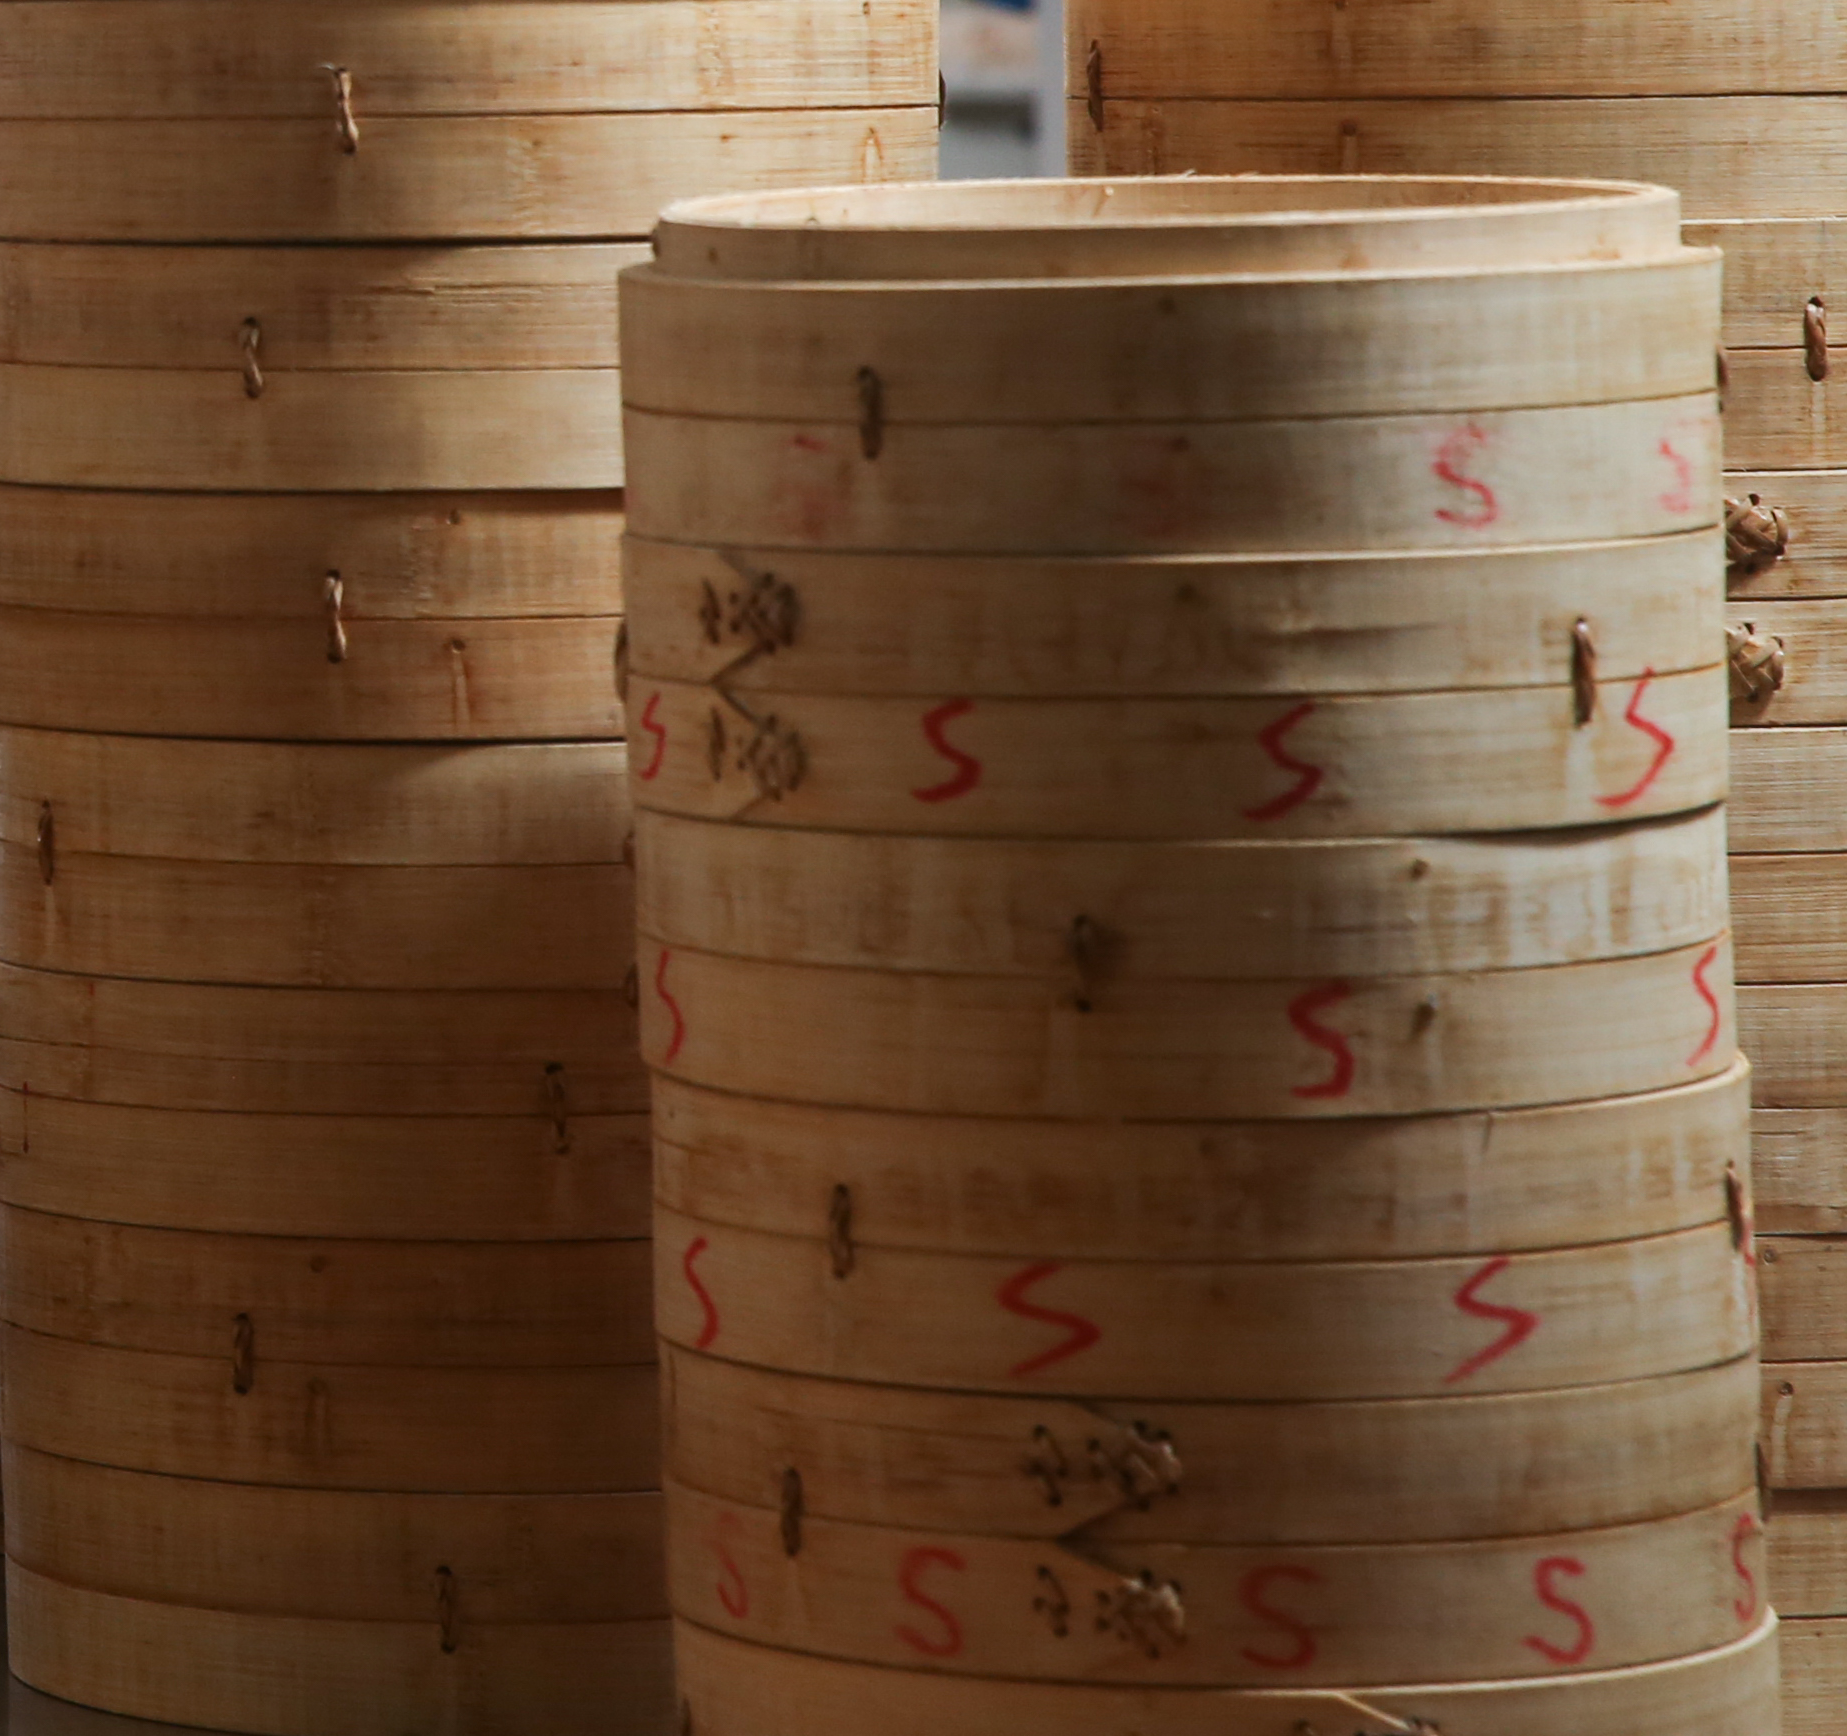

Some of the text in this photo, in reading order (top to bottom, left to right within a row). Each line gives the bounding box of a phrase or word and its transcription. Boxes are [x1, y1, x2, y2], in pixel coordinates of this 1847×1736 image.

[913, 697, 983, 804] S
[1242, 702, 1323, 822] S
[1595, 667, 1676, 809] S
[1287, 979, 1357, 1100] S
[1686, 946, 1720, 1068] S
[996, 1262, 1102, 1378] S
[1443, 1253, 1542, 1385] S
[897, 1546, 967, 1659] S
[1238, 1563, 1327, 1671] S
[1524, 1555, 1596, 1666] S
